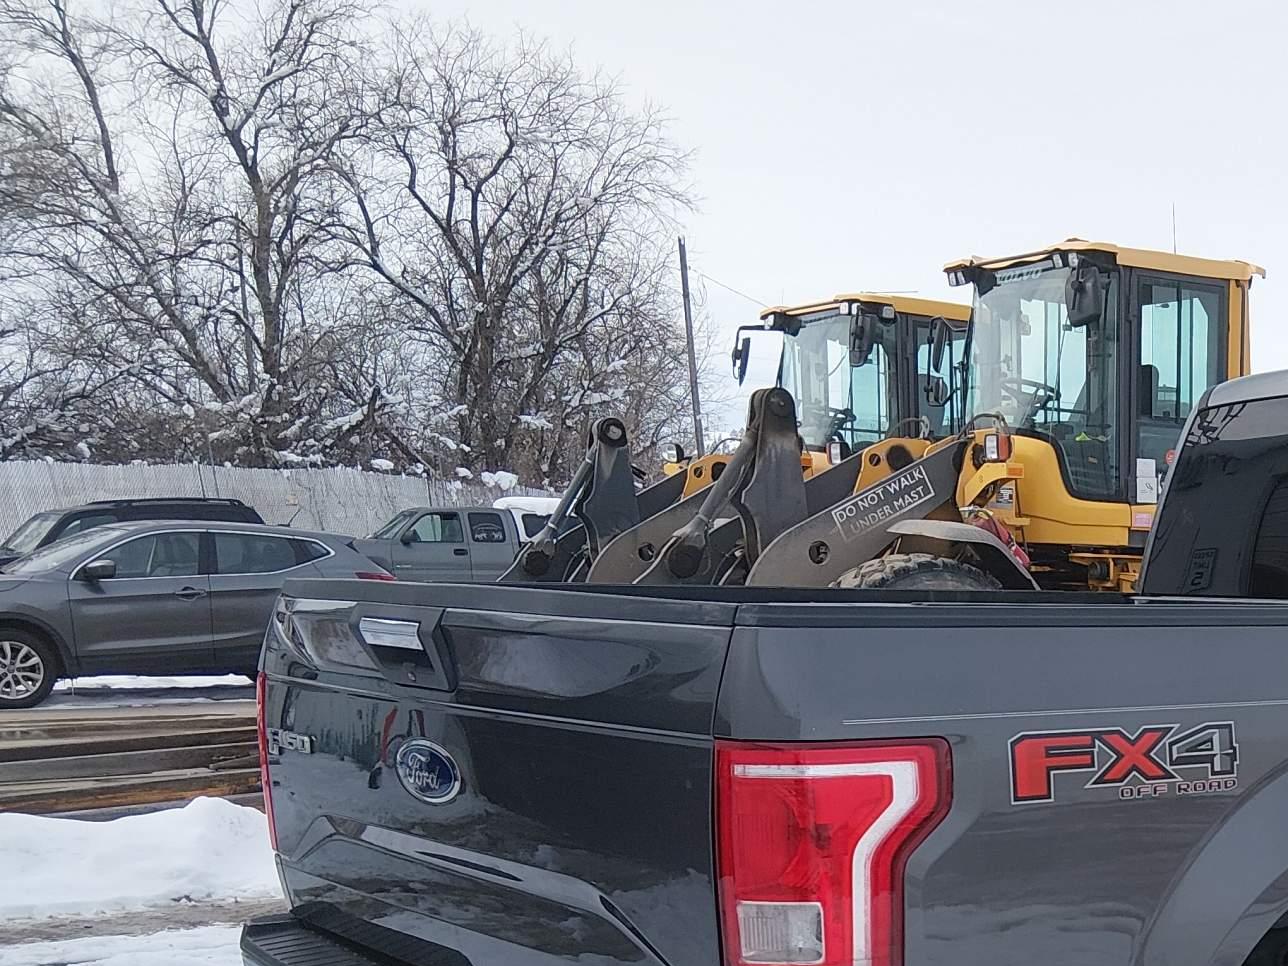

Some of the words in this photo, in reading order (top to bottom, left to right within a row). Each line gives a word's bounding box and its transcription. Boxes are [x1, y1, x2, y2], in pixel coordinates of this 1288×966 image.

[995, 268, 1042, 285] VOLVO
[836, 506, 856, 522] DO
[857, 488, 884, 511] NOT
[886, 468, 923, 494] WALK
[850, 505, 893, 533] UNDER
[893, 486, 925, 511] MAST
[405, 751, 442, 791] Ford
[1008, 721, 1240, 805] FX4
[1119, 783, 1169, 800] OFF
[1176, 777, 1239, 796] ROAD
